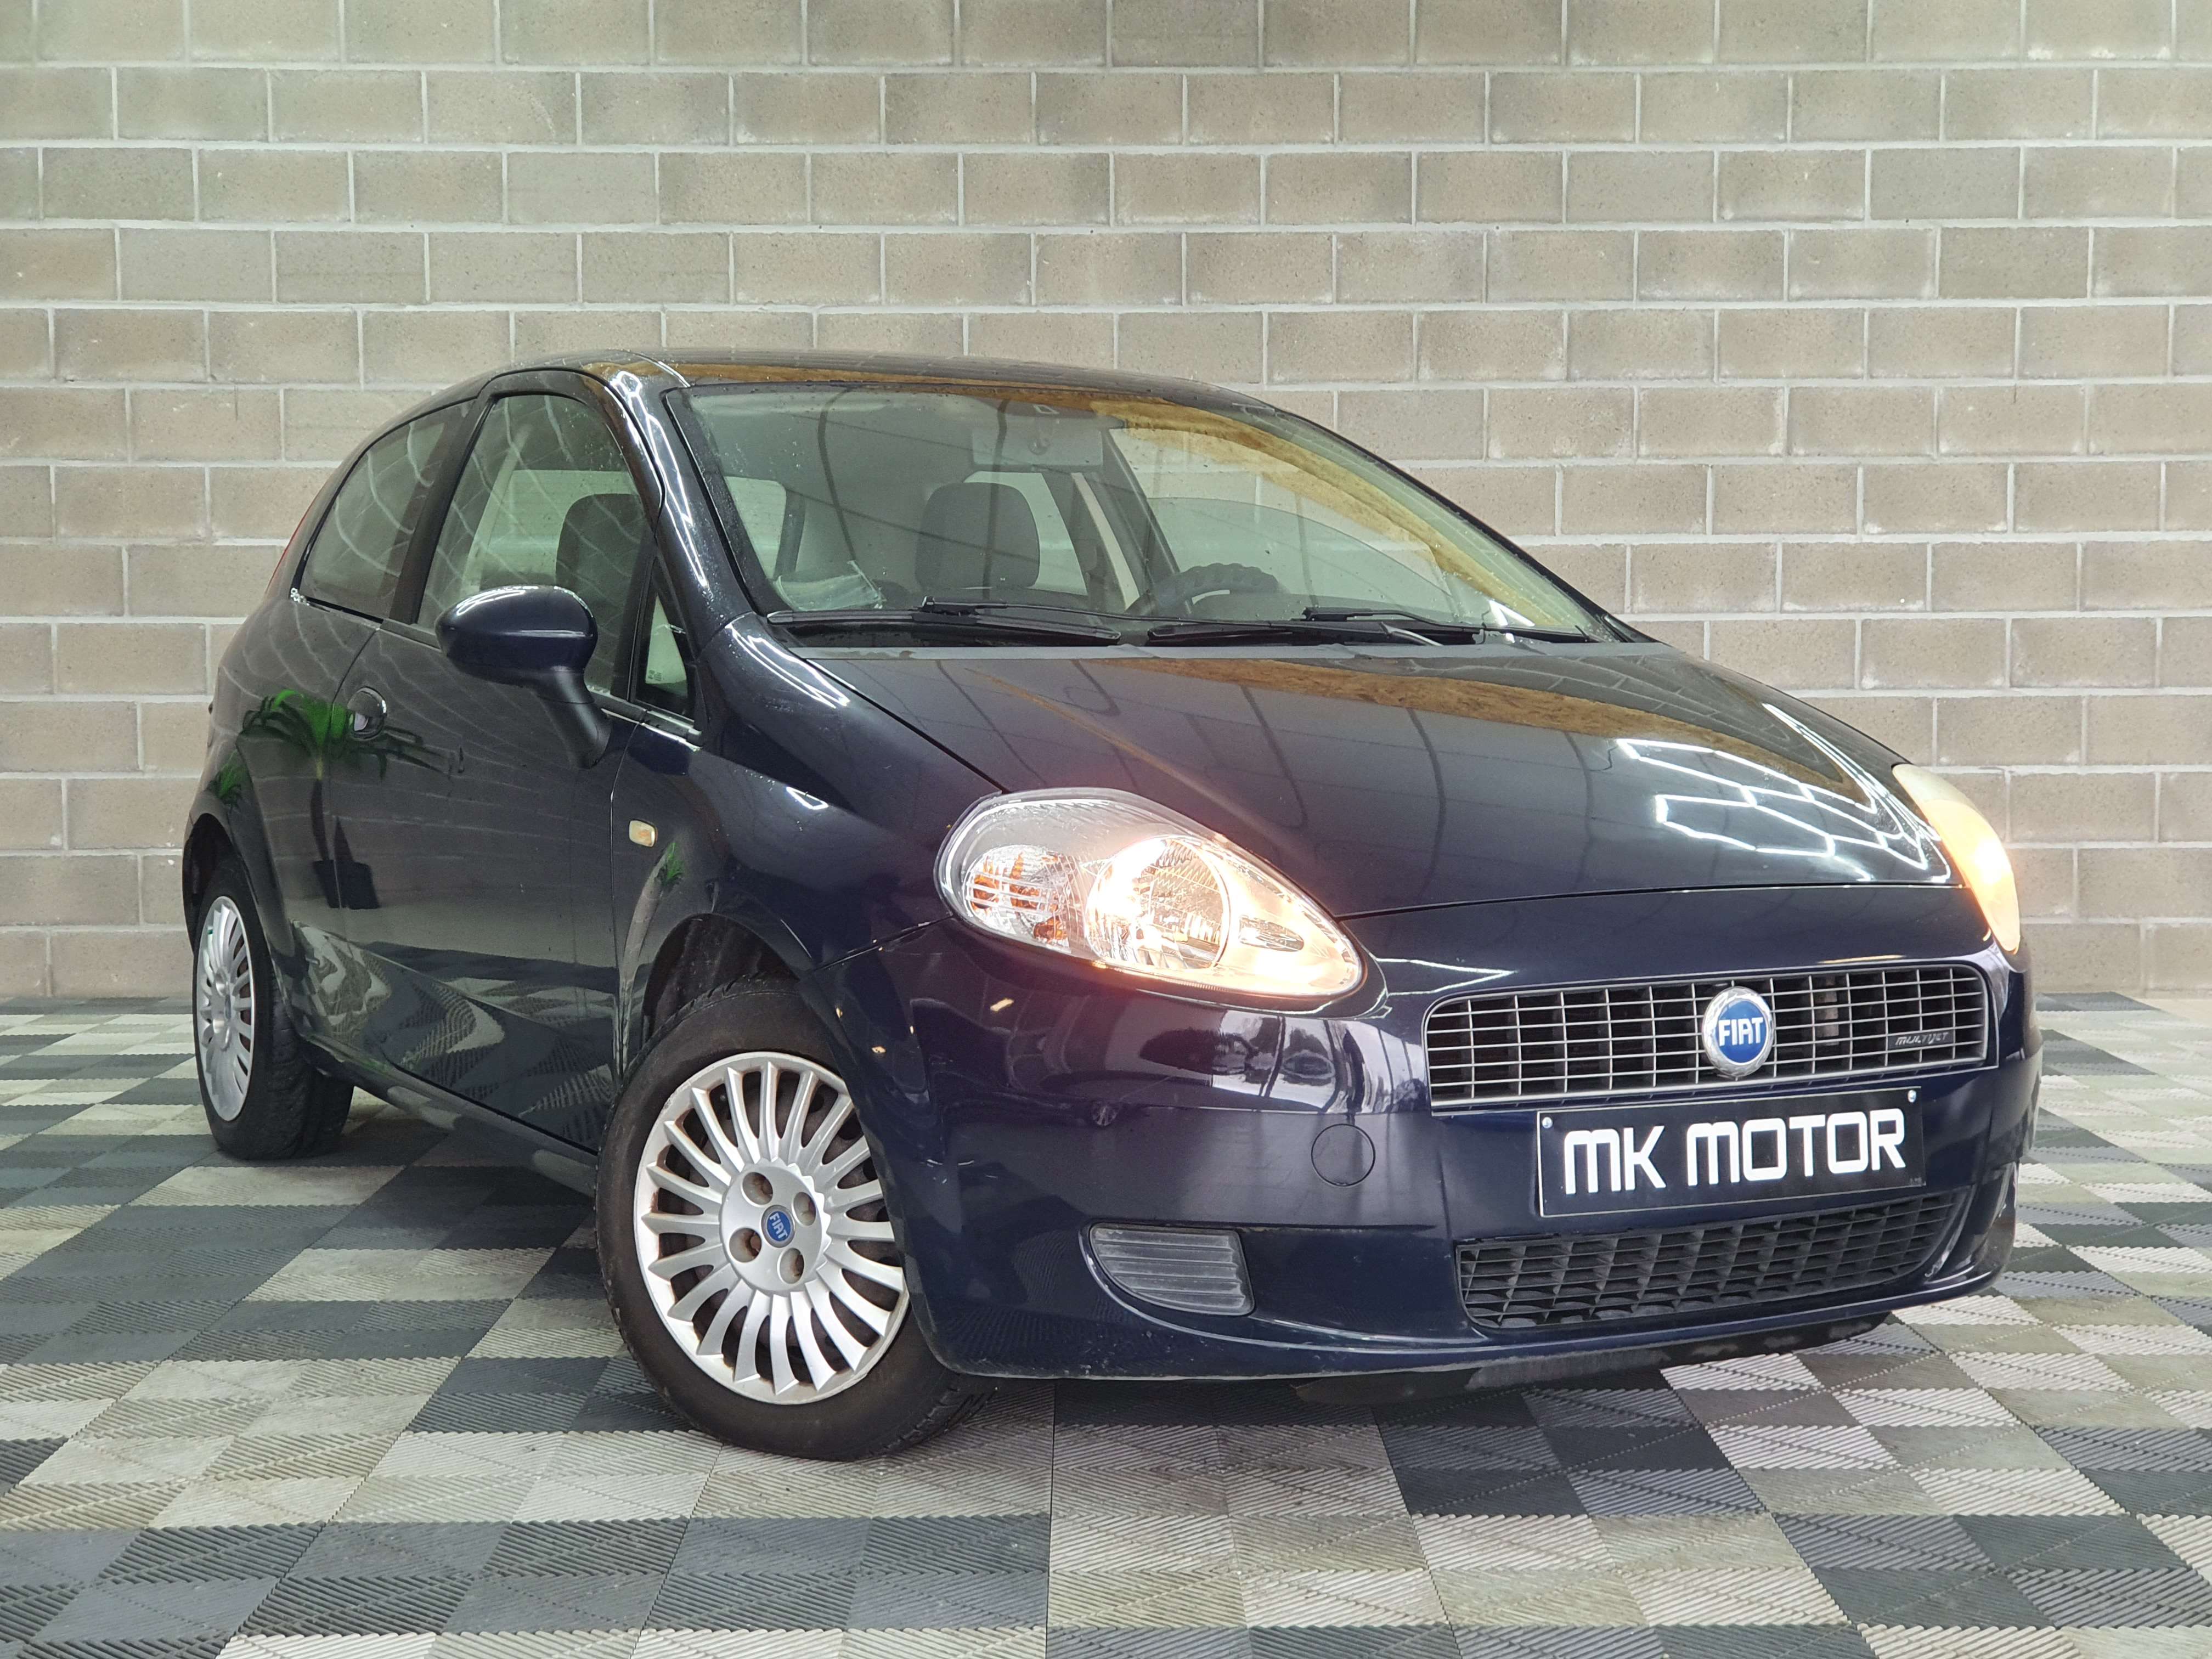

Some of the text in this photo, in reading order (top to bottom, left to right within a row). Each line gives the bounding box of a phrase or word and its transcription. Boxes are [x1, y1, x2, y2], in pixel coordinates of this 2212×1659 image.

[1718, 1017, 1763, 1047] FIAT
[1564, 1108, 1906, 1195] MK MOTOR
[769, 1212, 788, 1239] FIAT
